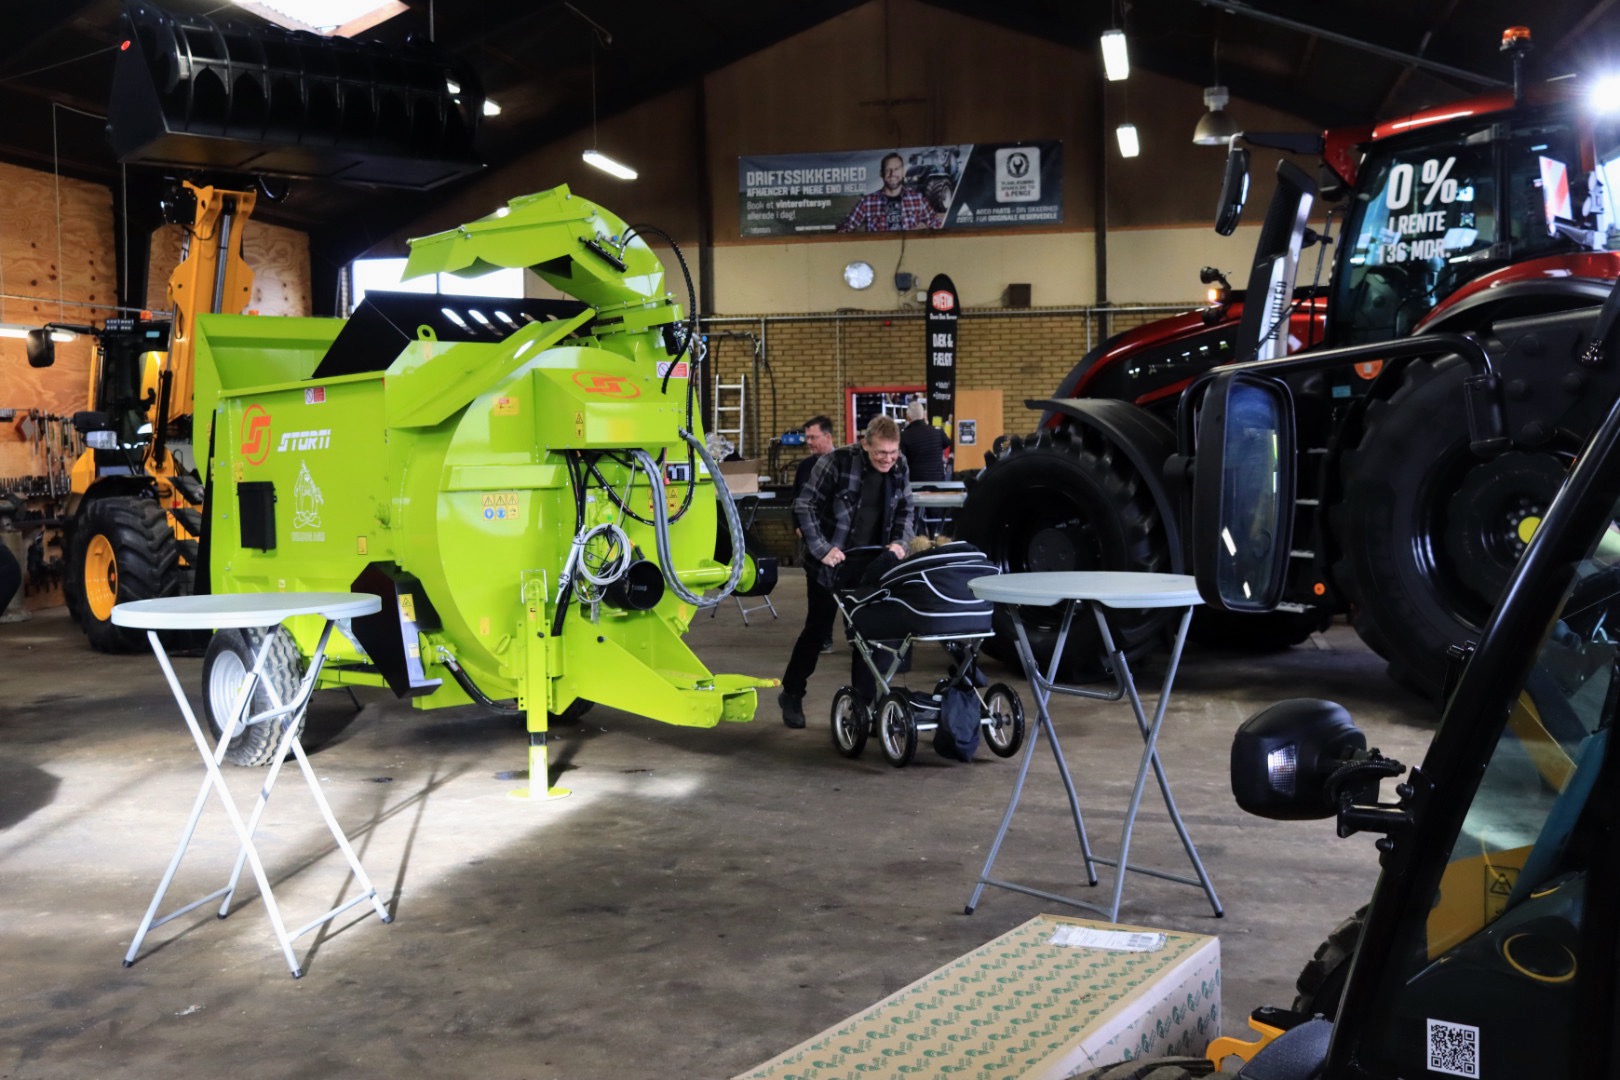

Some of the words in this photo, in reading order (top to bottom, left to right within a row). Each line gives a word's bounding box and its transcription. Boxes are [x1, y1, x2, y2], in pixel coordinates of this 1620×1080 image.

[746, 167, 867, 186] DRIFTSSIKKERHED
[790, 186, 800, 195] AF
[803, 185, 824, 194] MERE
[826, 184, 842, 193] END
[747, 201, 764, 210] Book
[776, 199, 832, 209] vintereftersyn
[747, 211, 774, 220] allerede
[780, 210, 796, 221] dag!
[1397, 211, 1447, 235] RENTE
[1410, 238, 1452, 261] MDR.
[947, 333, 954, 348] &
[277, 429, 332, 452] STORTI
